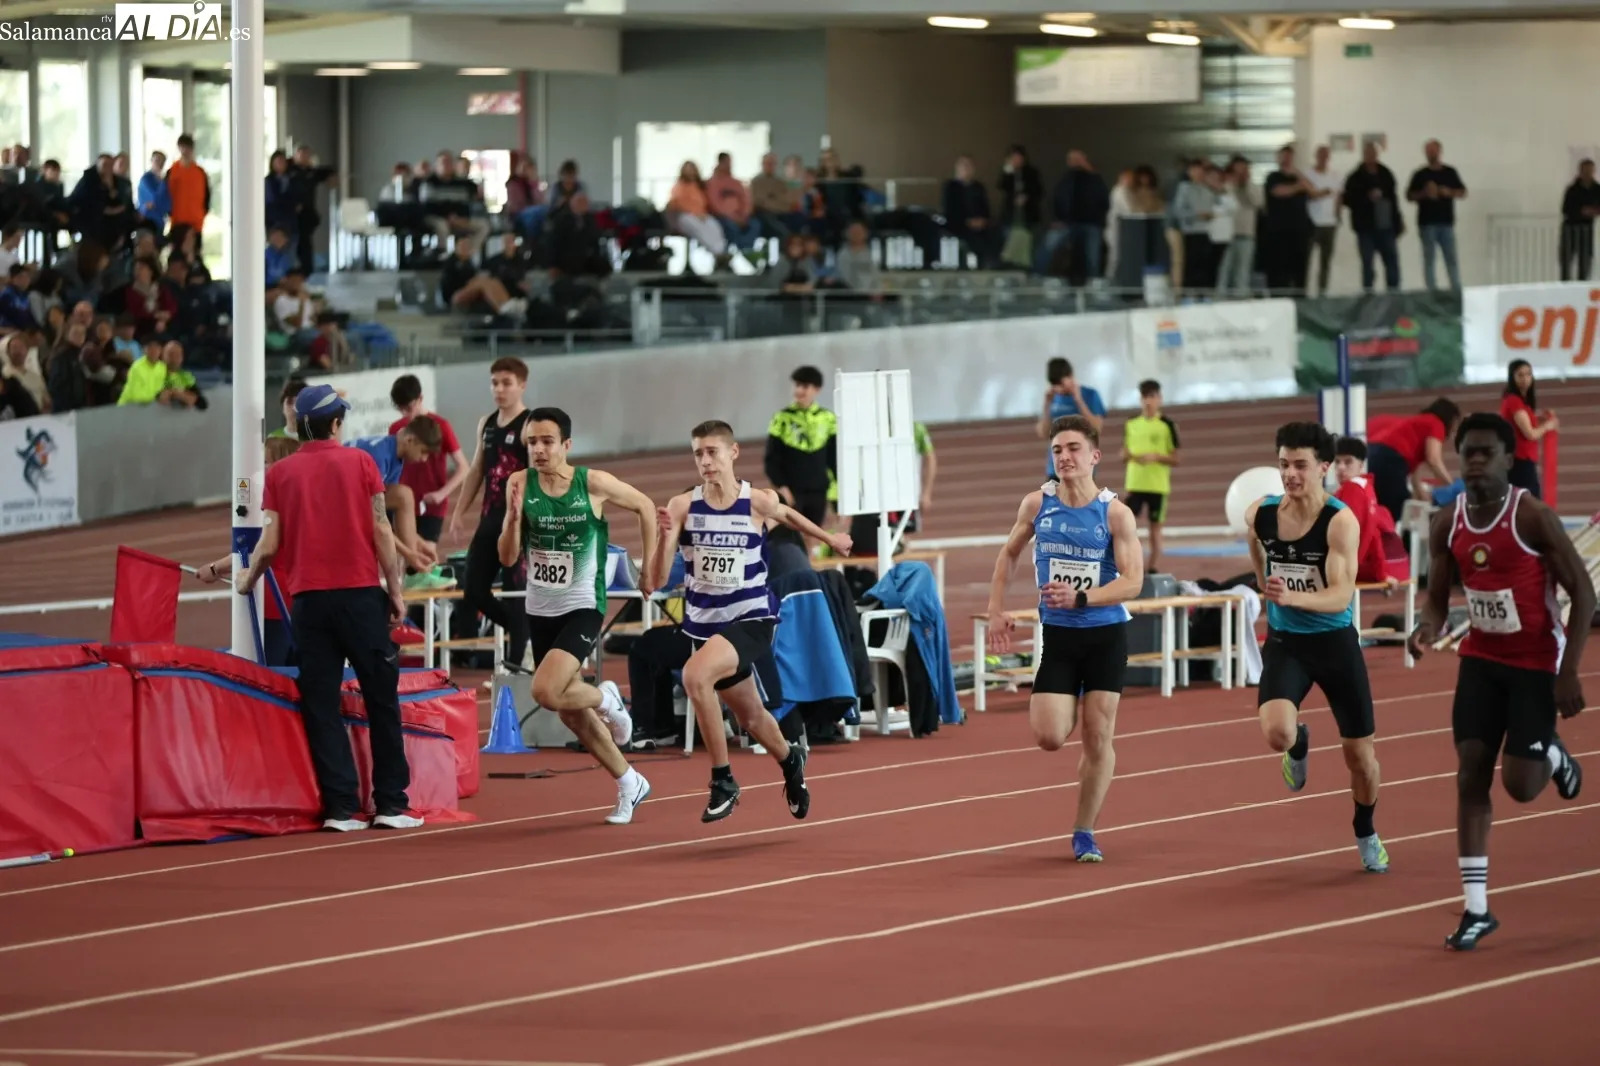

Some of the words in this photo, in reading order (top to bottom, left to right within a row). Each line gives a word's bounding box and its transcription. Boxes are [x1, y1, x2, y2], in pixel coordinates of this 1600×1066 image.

[1502, 288, 1600, 366] enj
[538, 513, 587, 523] universidad
[547, 523, 565, 531] león
[691, 533, 749, 547] RACING
[533, 561, 567, 584] 2882
[702, 555, 735, 574] 2797
[1279, 576, 1318, 593] 905
